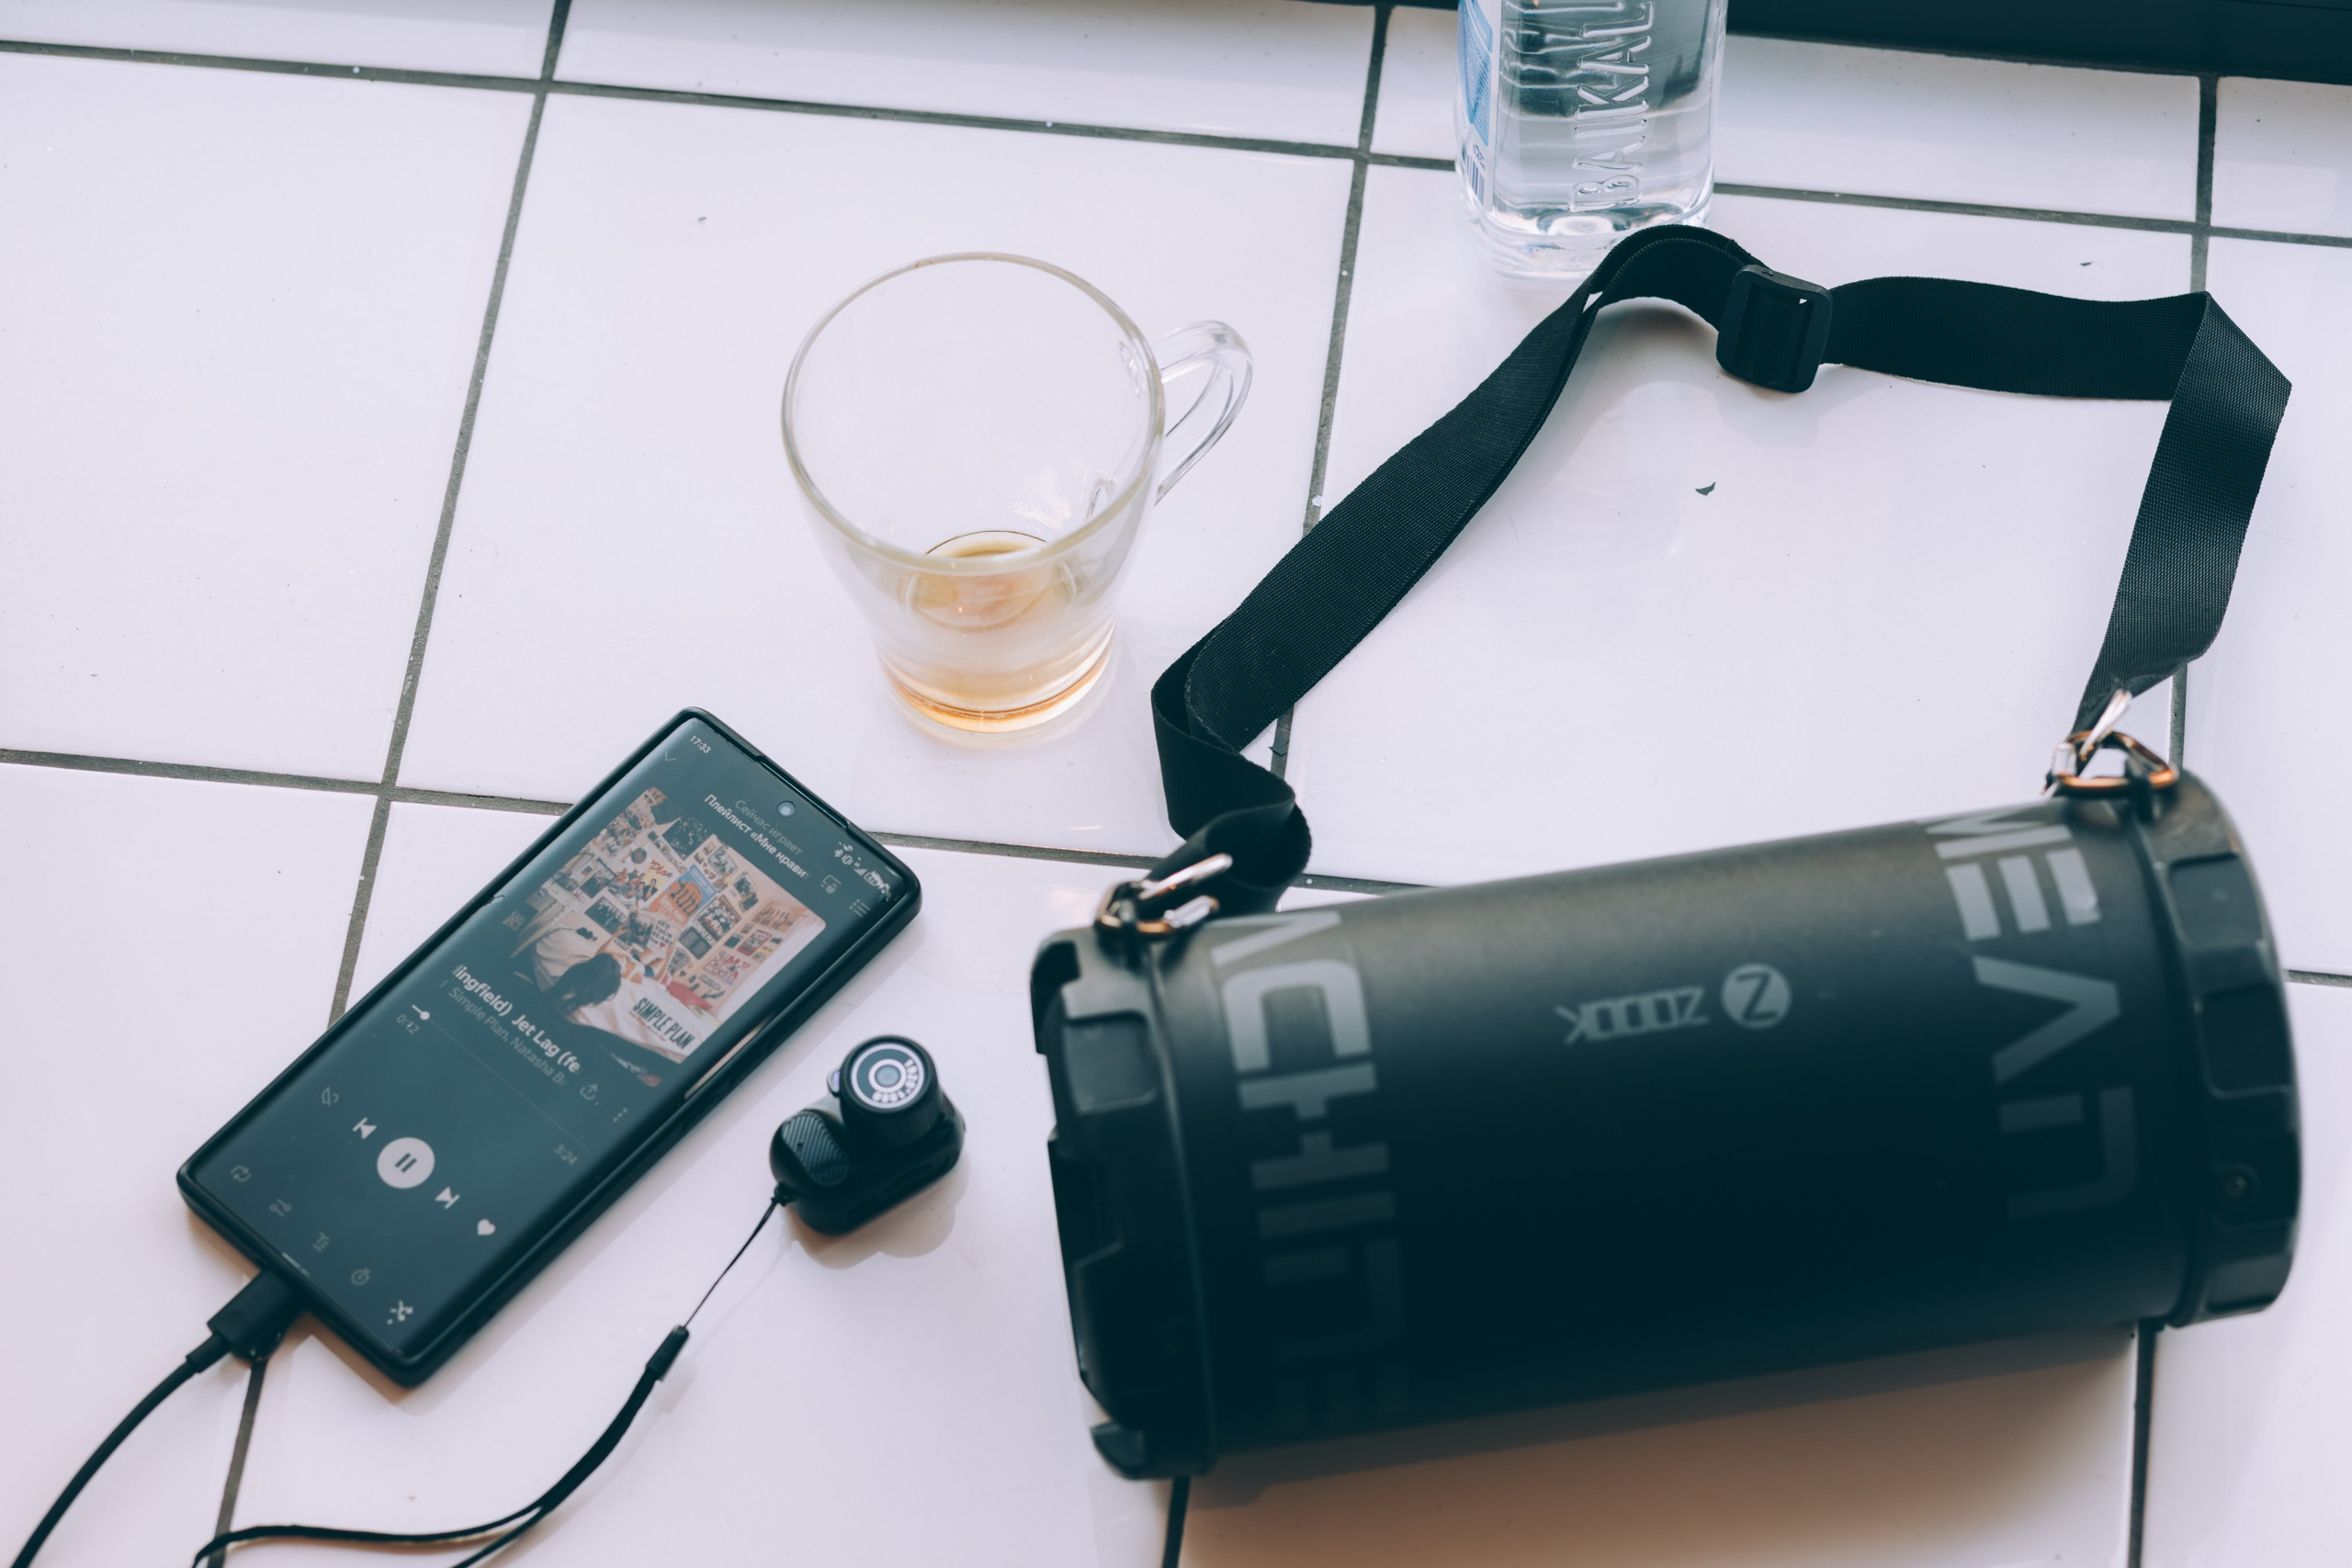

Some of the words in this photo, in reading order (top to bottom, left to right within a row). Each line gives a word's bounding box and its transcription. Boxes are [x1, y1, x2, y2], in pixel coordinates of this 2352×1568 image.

[688, 735, 711, 754] 17:33
[703, 793, 752, 834] Плейлист
[749, 829, 777, 854] «Мне
[733, 798, 771, 830] Сейчас
[767, 827, 803, 856] играет
[395, 1014, 420, 1036] 0:12
[447, 986, 488, 1021] Simple
[508, 1035, 556, 1077] Natasha
[510, 1013, 537, 1037] Jet
[531, 1030, 562, 1058] Lag
[631, 996, 673, 1032] SIMPLE
[663, 1021, 695, 1050] PLAN
[551, 1143, 578, 1167] 3:24
